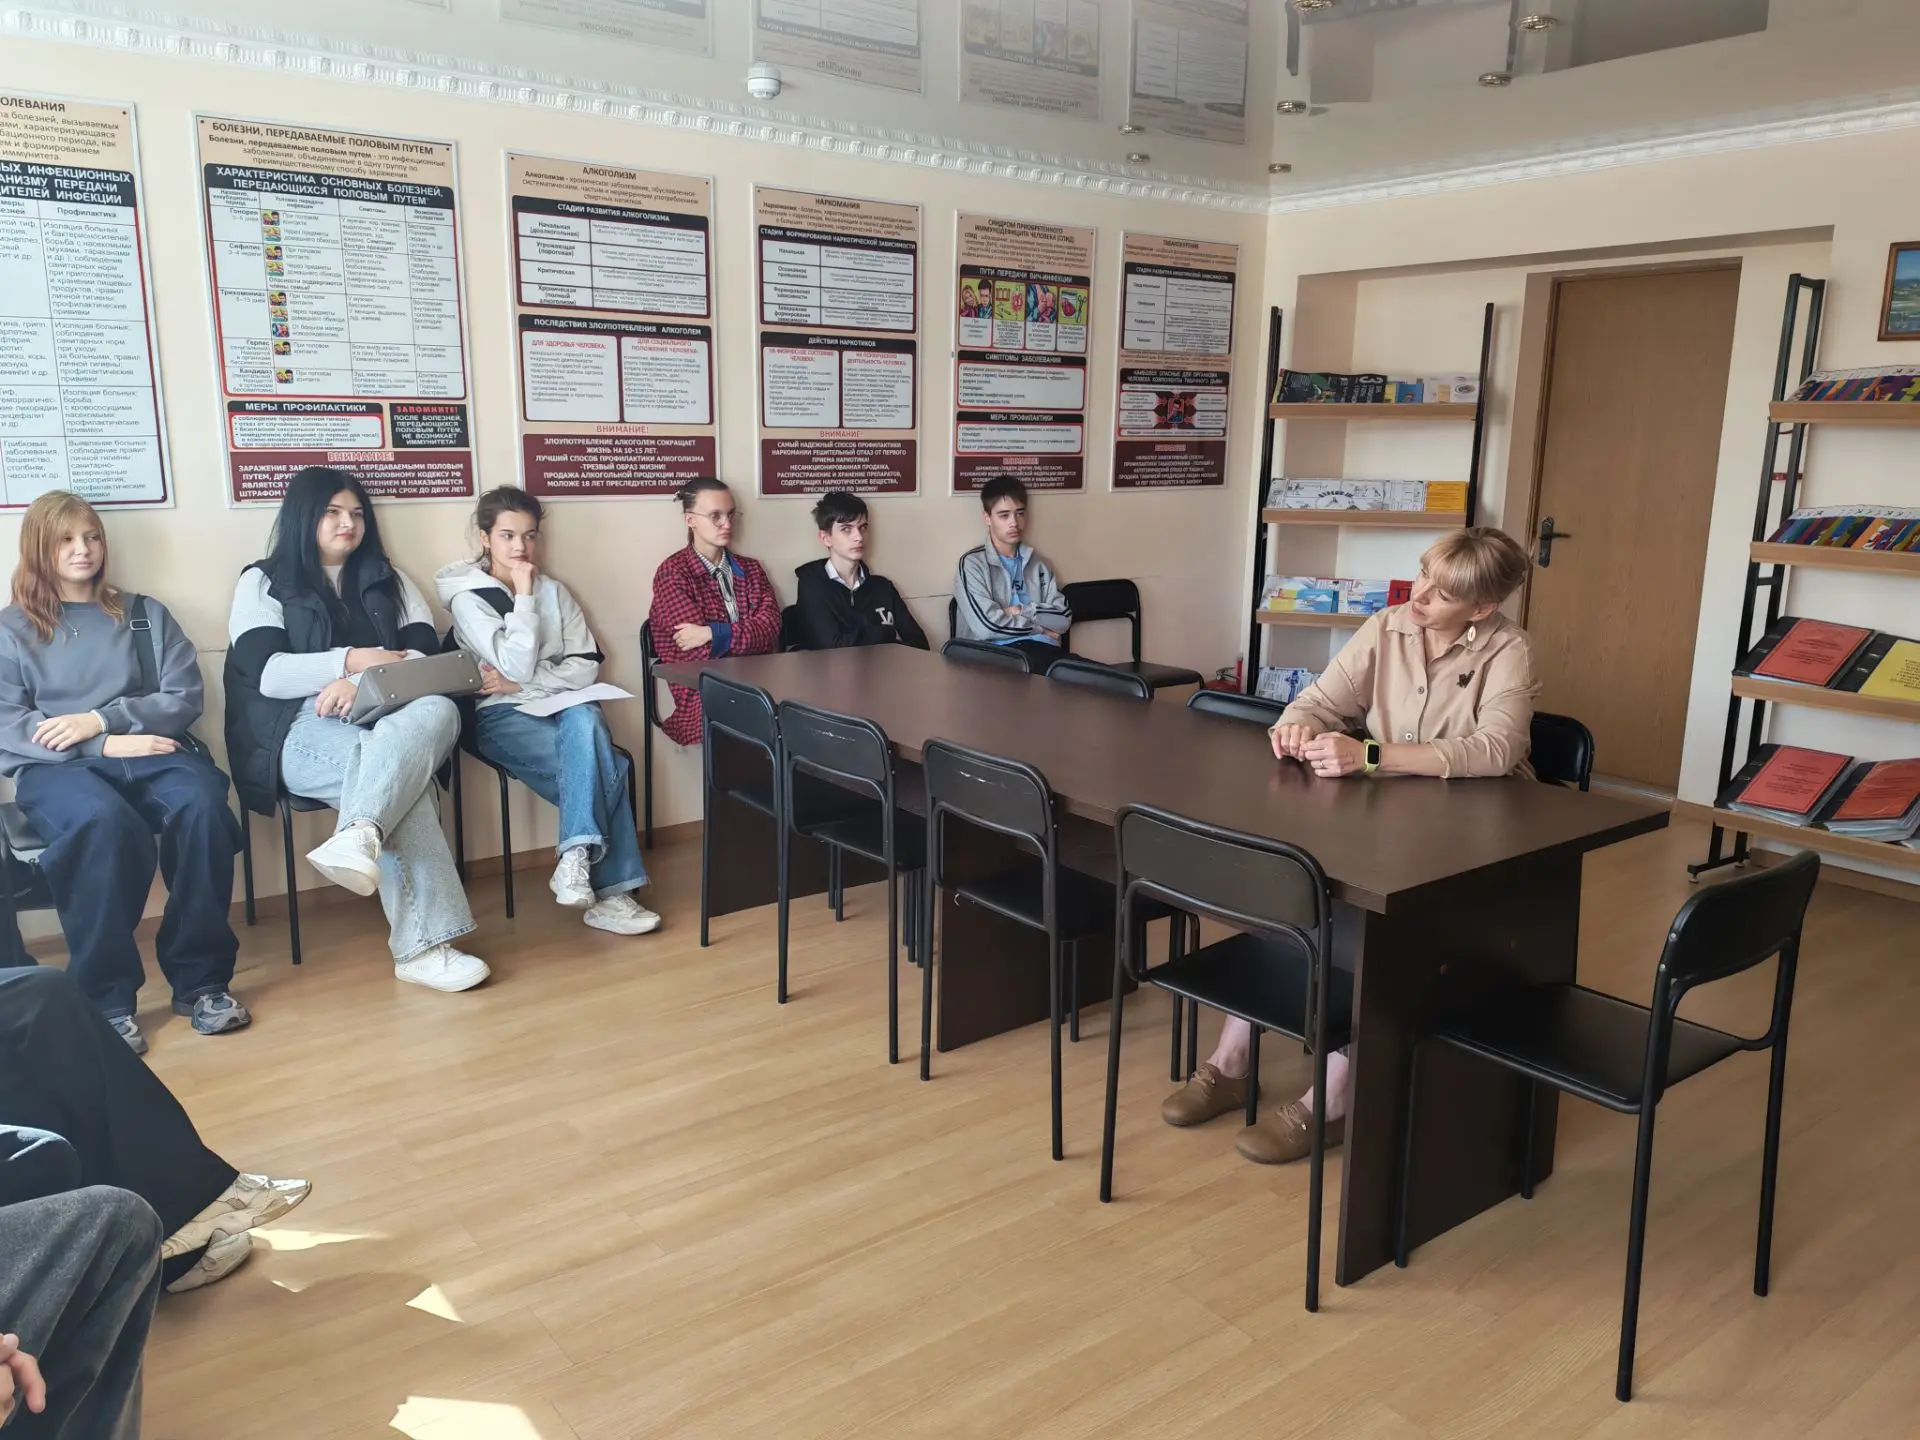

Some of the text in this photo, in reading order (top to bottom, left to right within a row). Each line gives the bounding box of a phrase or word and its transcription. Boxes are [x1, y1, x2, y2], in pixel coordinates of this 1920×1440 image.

[62, 119, 119, 129] вызываемых
[24, 124, 115, 138] характеризующаяся
[58, 137, 99, 147] периода,
[212, 122, 433, 155] БОЛЕЗНИ, ПЕРЕДАВАЕМЫЕ ПОЛОВЫМ ПУТЕМ
[23, 142, 100, 154] формированием
[209, 135, 246, 145] Болезни,
[249, 139, 308, 151] передаваемые
[311, 145, 347, 155] половым
[2, 150, 61, 160] иммунитета.
[28, 165, 130, 182] ИНФЕКЦИОННЫХ
[583, 166, 636, 180] АЛКОГОЛИЗМ
[55, 179, 117, 192] ПЕРЕДАЧИ
[217, 167, 443, 197] ХАРАКТЕРИСТИКА ОСНОВНЫХ БОЛЕЗНЕЙ,
[56, 190, 121, 204] ИНФЕКЦИИ
[233, 179, 426, 204] ПЕРЕДАЮЩИХСЯ ПОЛОВЫМ ПУТЕМ
[816, 198, 860, 209] НАРКОМАНИЯ
[57, 207, 116, 218] Профилактика
[558, 204, 669, 221] СТАДИИ РАЗВИТИЯ АЛКОГОЛИЗМА
[43, 223, 82, 233] Изоляция
[786, 231, 832, 241] ФОРМИРОВАНИЯ
[833, 236, 877, 245] НАРКОТИЧЕСКОЙ
[538, 267, 575, 276] Критическая
[534, 319, 701, 335] ПОСЛЕДСТВИЯ ЗЛОУПОТРЕБЛЕНИЯ АЛКОГОЛЕМ
[1021, 355, 1062, 363] ЗАБОЛЕВАНИЯ
[246, 403, 366, 412] МЕРЫ ПРОФИЛАКТИКИ
[328, 452, 394, 461] ВНИМАНИЕ!
[361, 464, 425, 473] ПЕРЕДАВАЕМЫМИ
